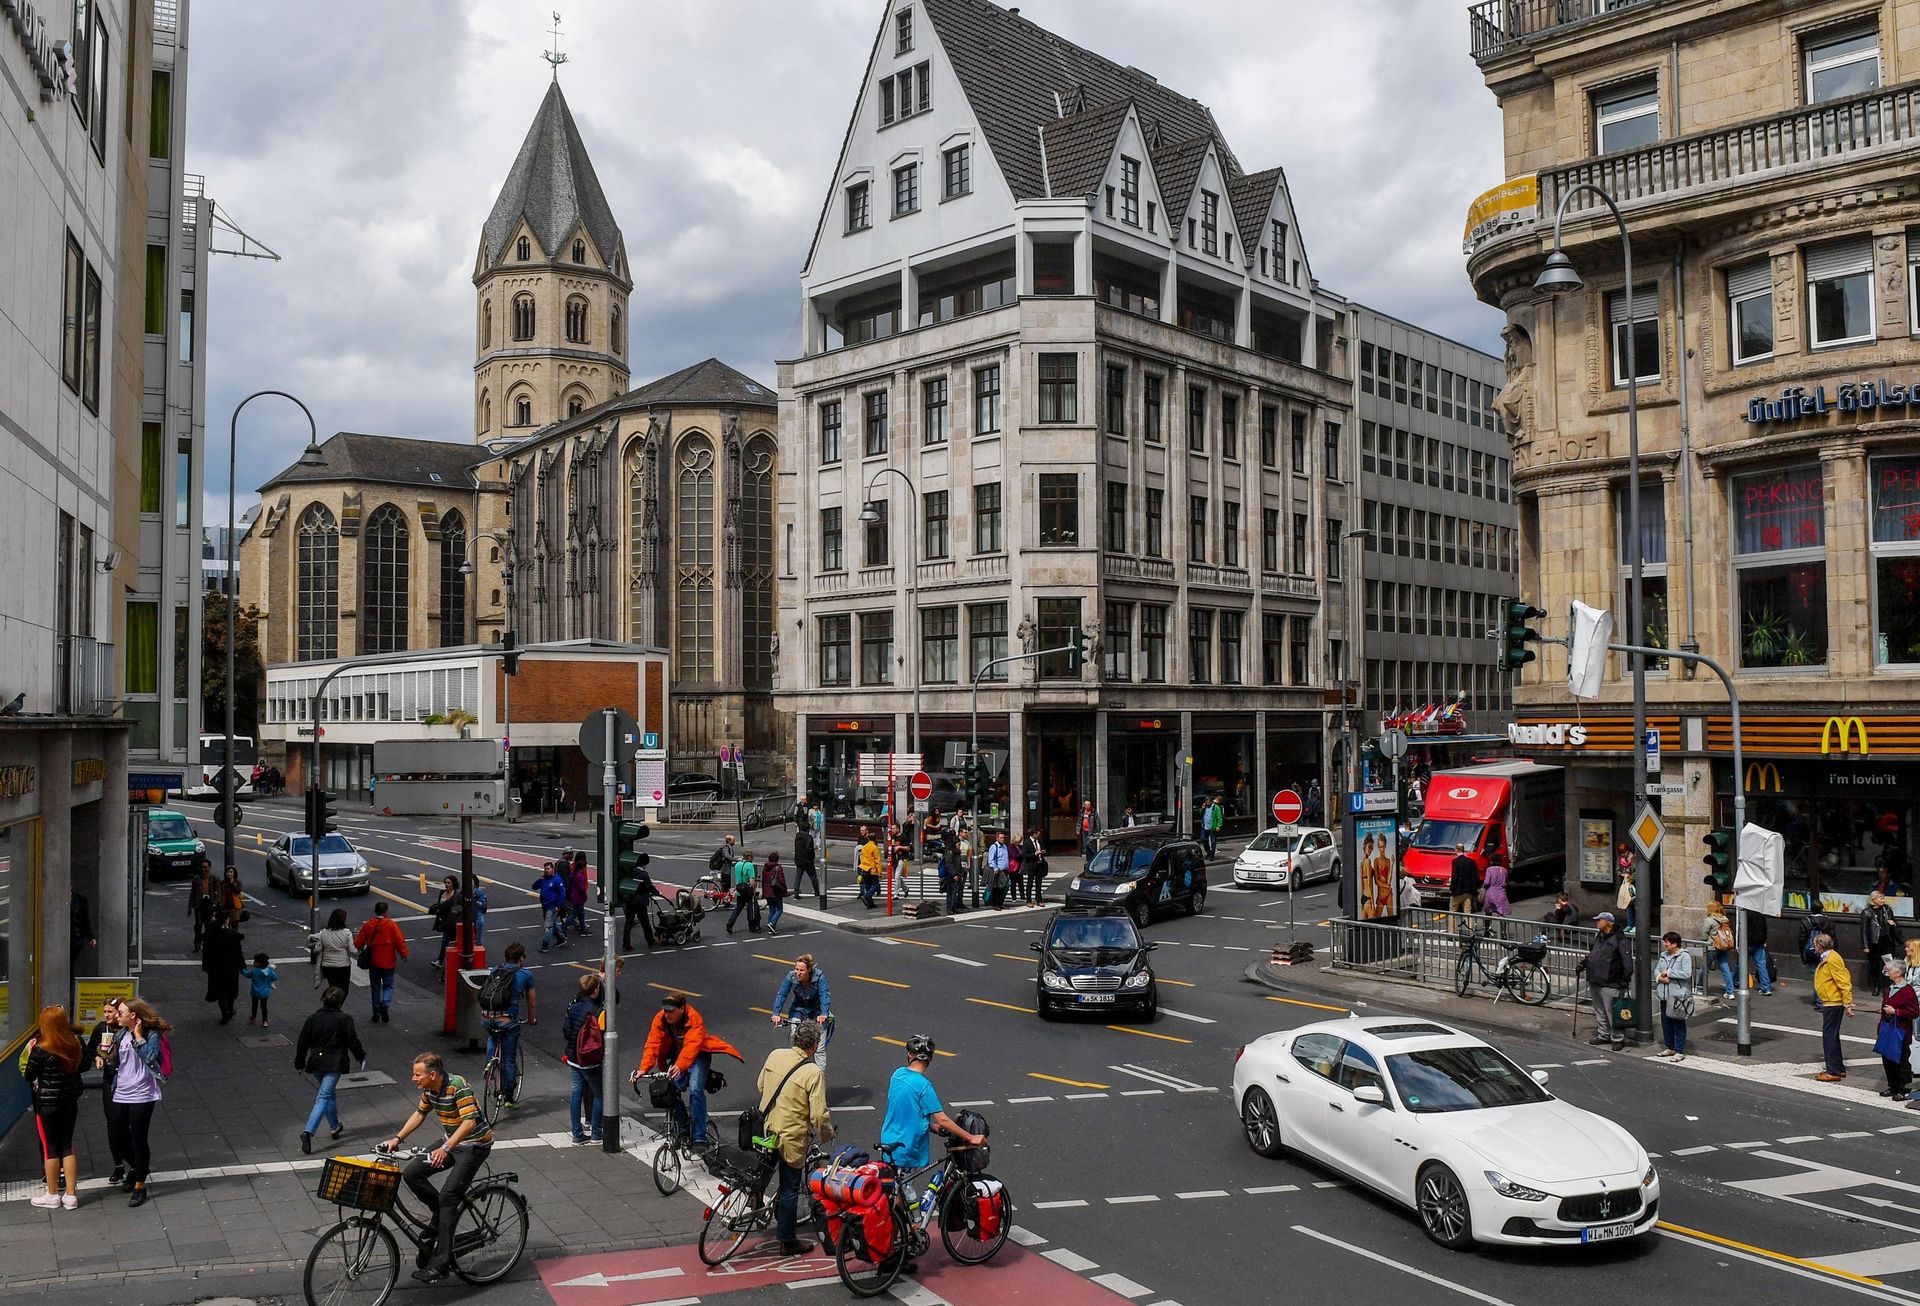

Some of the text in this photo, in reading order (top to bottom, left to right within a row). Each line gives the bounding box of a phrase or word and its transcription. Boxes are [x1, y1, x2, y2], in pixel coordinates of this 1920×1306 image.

[1748, 378, 1920, 423] Gaffel Kölsc
[1745, 477, 1824, 509] PEKING
[646, 735, 655, 747] U
[1829, 773, 1849, 785] i'm
[1650, 785, 1684, 794] Trankgasse
[1353, 795, 1362, 810] U
[1360, 820, 1391, 828] CALZEDONIA
[1614, 1224, 1633, 1237] 1099
